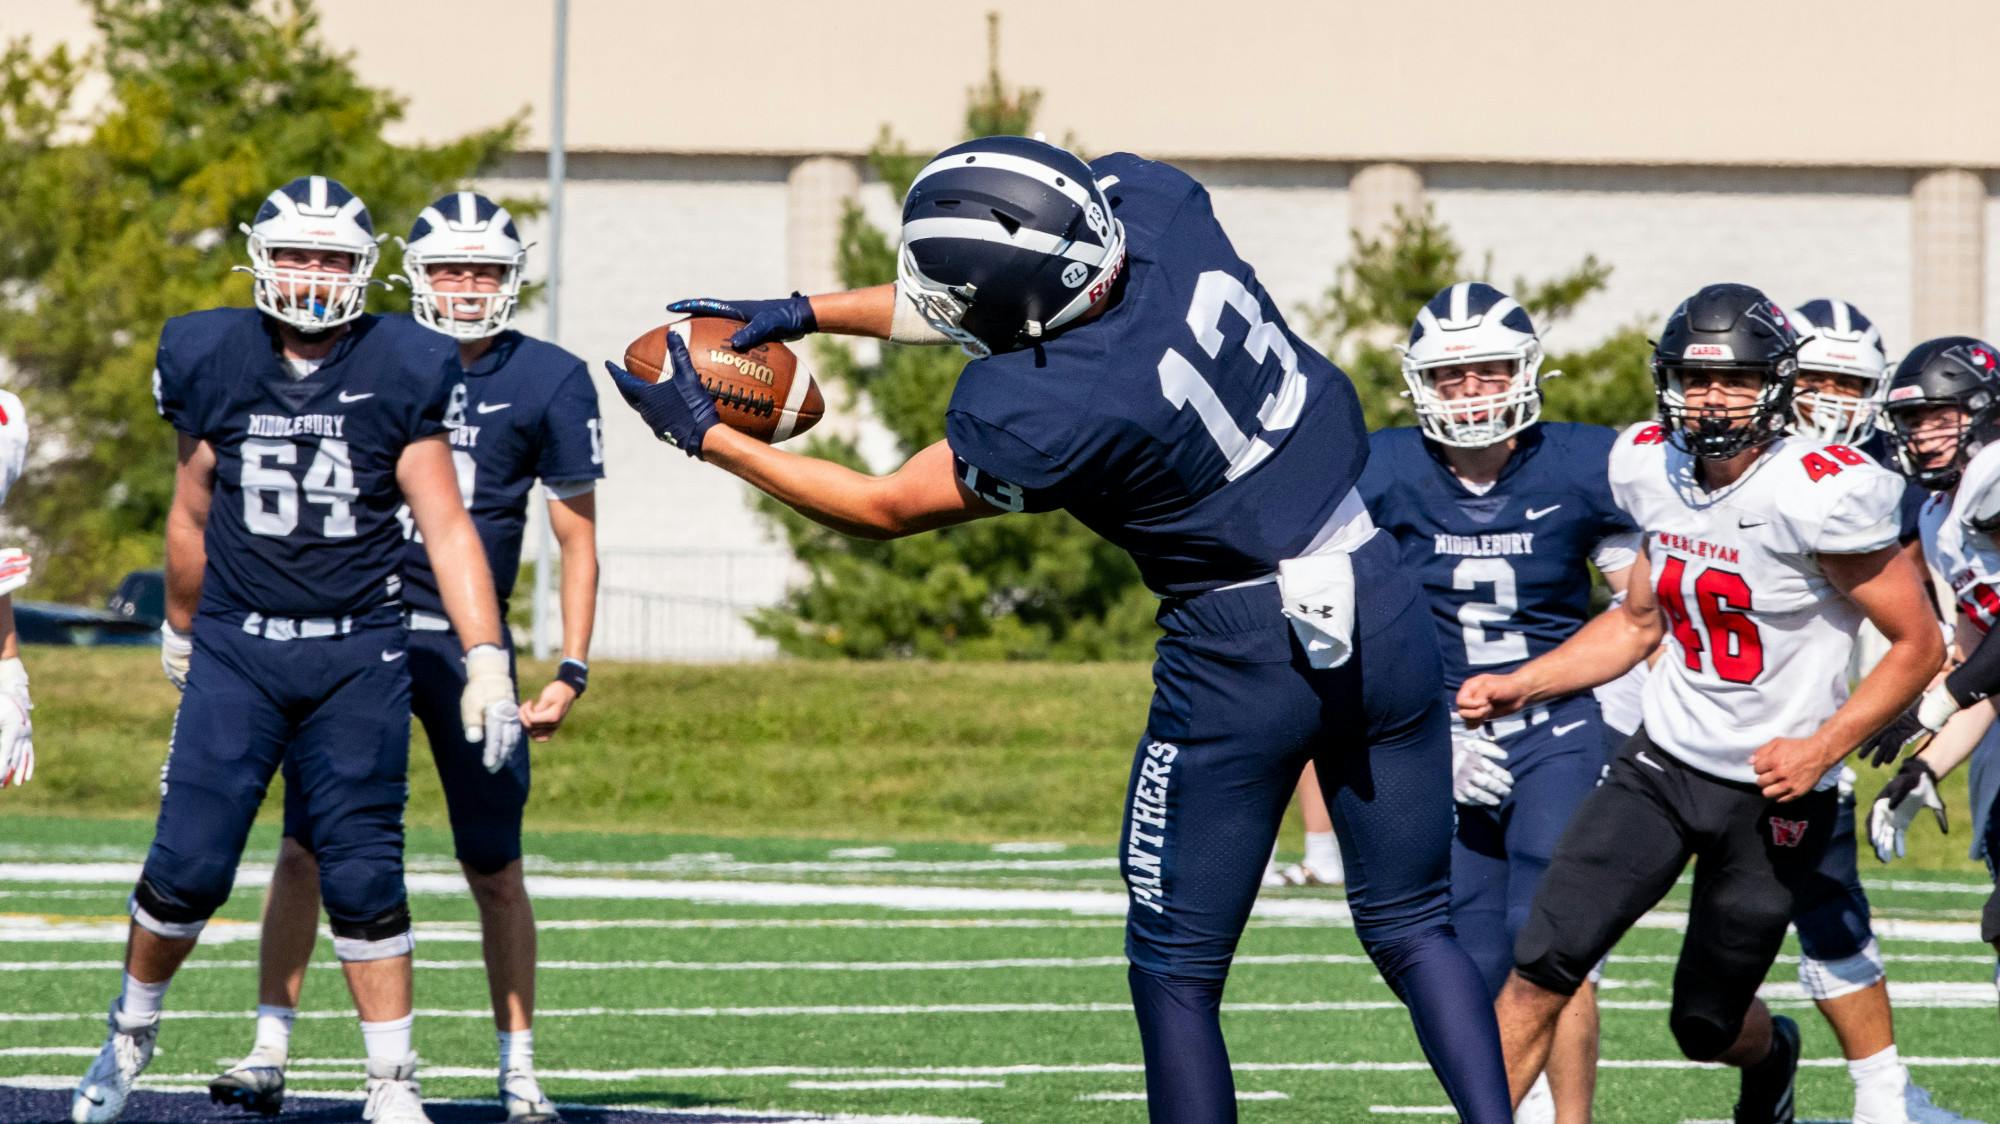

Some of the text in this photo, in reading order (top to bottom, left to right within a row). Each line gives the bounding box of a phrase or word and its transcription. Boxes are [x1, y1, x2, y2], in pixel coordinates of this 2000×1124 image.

[710, 350, 775, 386] Wilson
[1157, 270, 1308, 482] 13
[247, 413, 346, 438] MIDDLEBURY
[240, 437, 360, 538] 64
[1801, 444, 1869, 484] 46
[1433, 532, 1534, 556] MIDDLEBURY
[1659, 532, 1740, 564] WESLEYAN
[1452, 557, 1530, 665] 2
[1656, 554, 1764, 685] 46
[1128, 740, 1179, 914] PANTHERS
